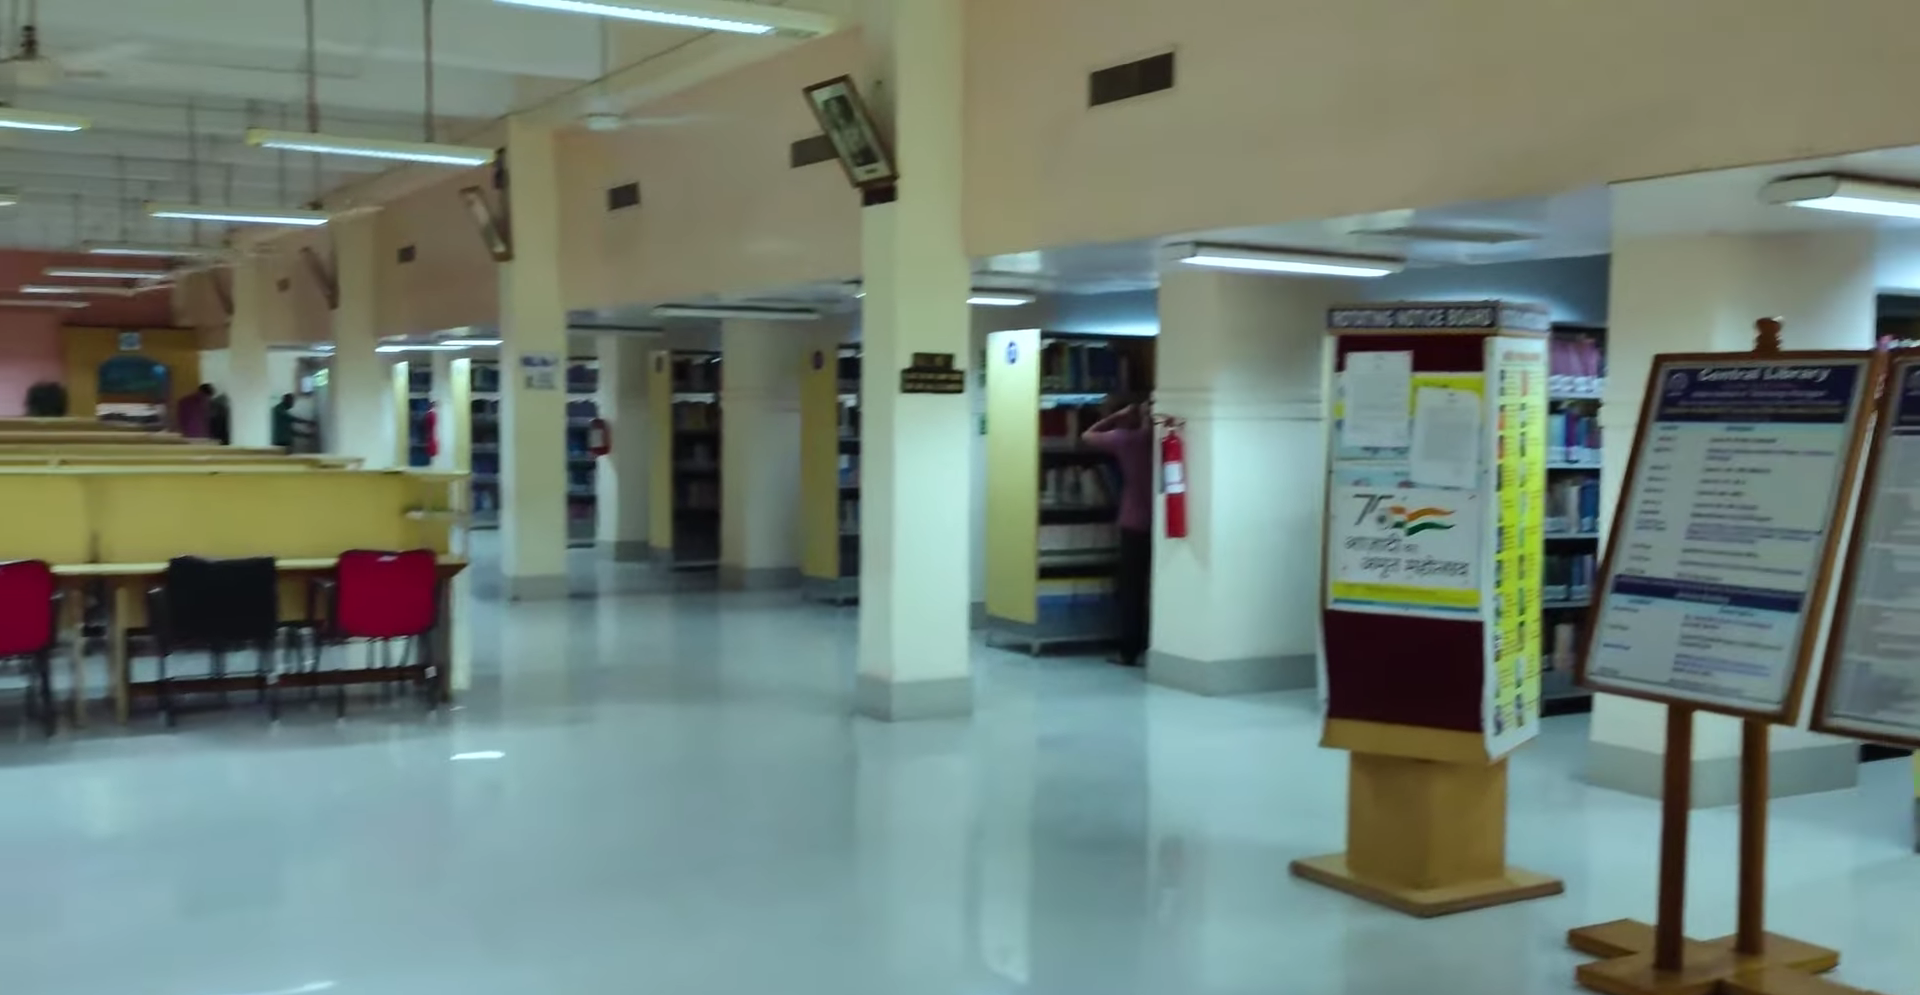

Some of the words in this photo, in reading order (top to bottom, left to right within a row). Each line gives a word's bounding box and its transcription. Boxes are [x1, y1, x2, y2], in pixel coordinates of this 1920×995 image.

[1397, 308, 1446, 327] NOTICE
[1448, 307, 1494, 327] BOARD
[1697, 367, 1761, 382] Central
[1763, 366, 1832, 383] Library
